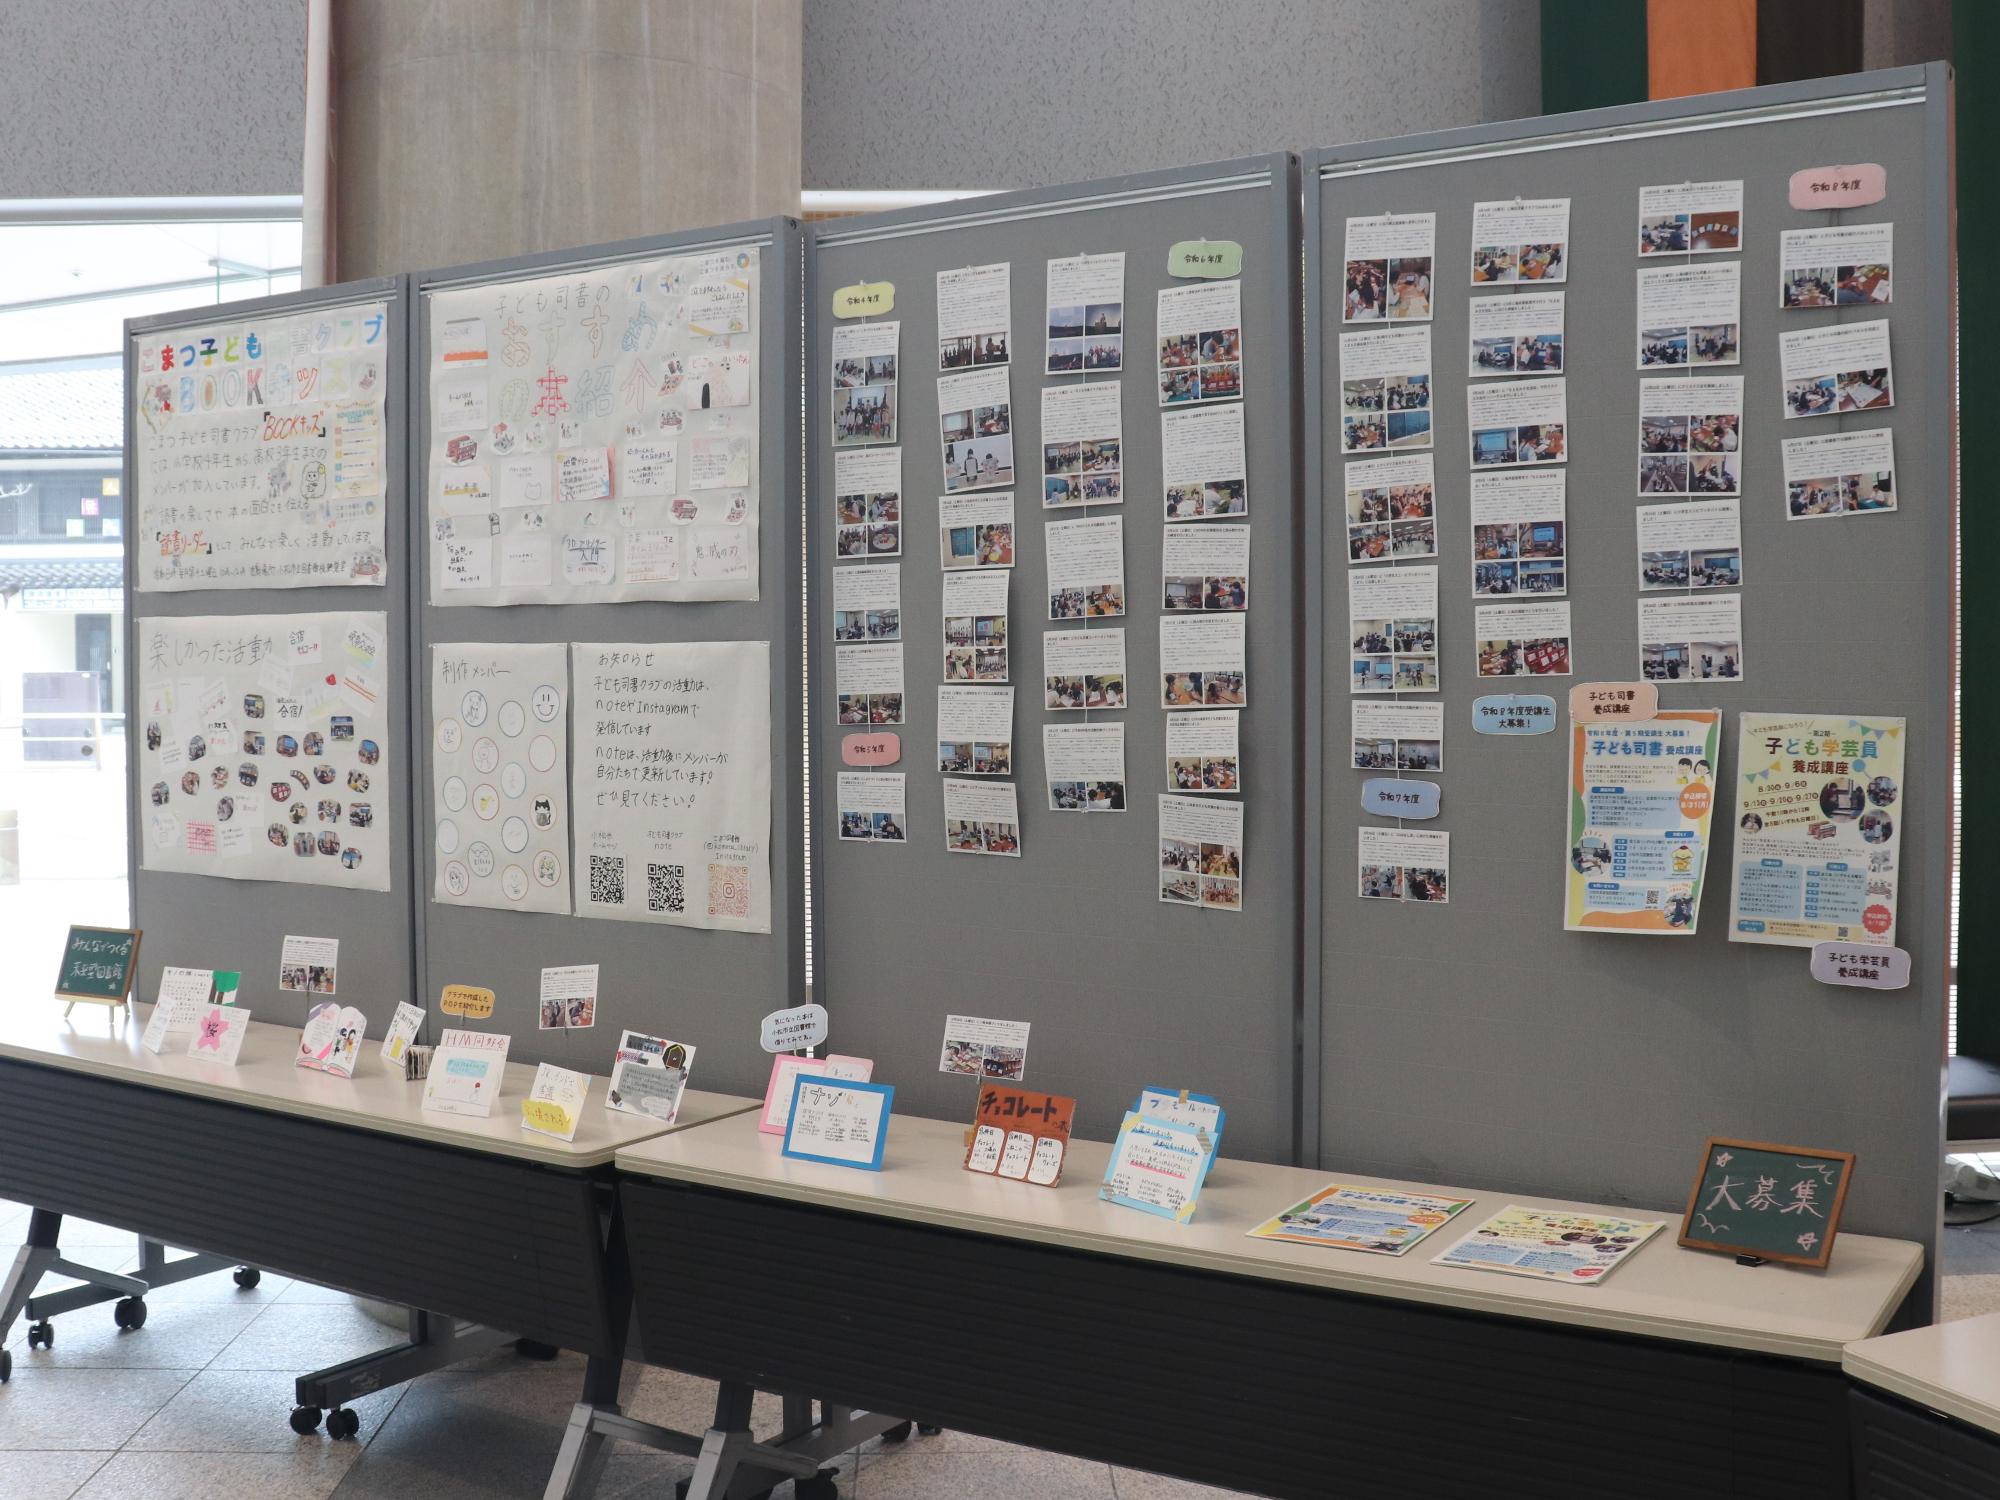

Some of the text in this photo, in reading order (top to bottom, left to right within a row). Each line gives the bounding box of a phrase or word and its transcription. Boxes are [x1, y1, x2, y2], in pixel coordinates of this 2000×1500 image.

[1810, 179, 1862, 193] 令和8年度
[149, 631, 274, 673] 楽しかった活動
[1588, 690, 1636, 702] 子ども司書
[1592, 740, 1664, 757] 子ども司書
[1764, 736, 1879, 759] 子ども学芸員
[1792, 759, 1849, 775] 養成講座
[1378, 791, 1421, 804] 令和7年度
[1827, 952, 1891, 968] 子ども学芸員
[1837, 968, 1880, 981] 養成講座
[981, 1090, 1058, 1123] チョコレート
[1711, 1173, 1825, 1220] 大募集
